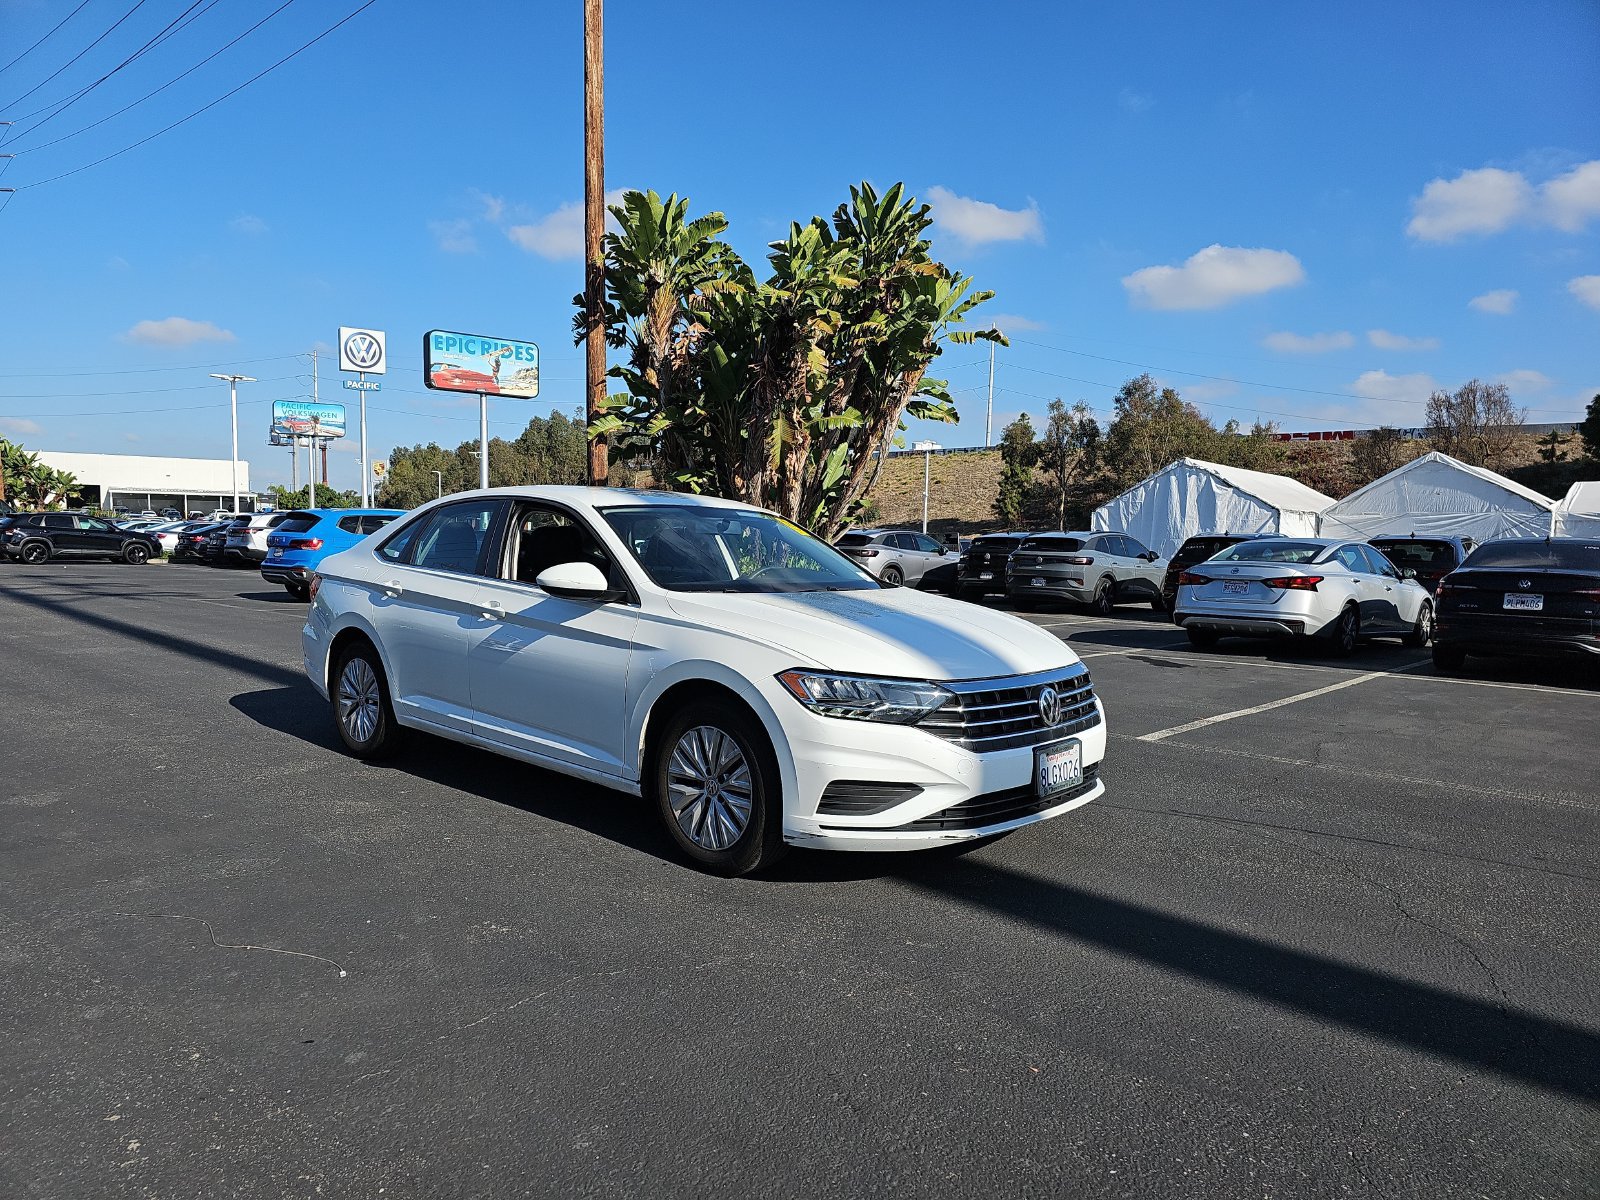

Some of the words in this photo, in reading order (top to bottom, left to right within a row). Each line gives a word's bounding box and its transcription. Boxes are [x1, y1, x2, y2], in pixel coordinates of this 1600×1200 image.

[347, 335, 379, 365] VW
[434, 335, 476, 355] EPIC
[481, 340, 535, 362] RIDES
[347, 380, 380, 390] PACIFIC
[281, 402, 312, 411] PACIFIC
[282, 409, 338, 419] VOLKSWAGEN
[1041, 758, 1079, 787] 8LGX026
